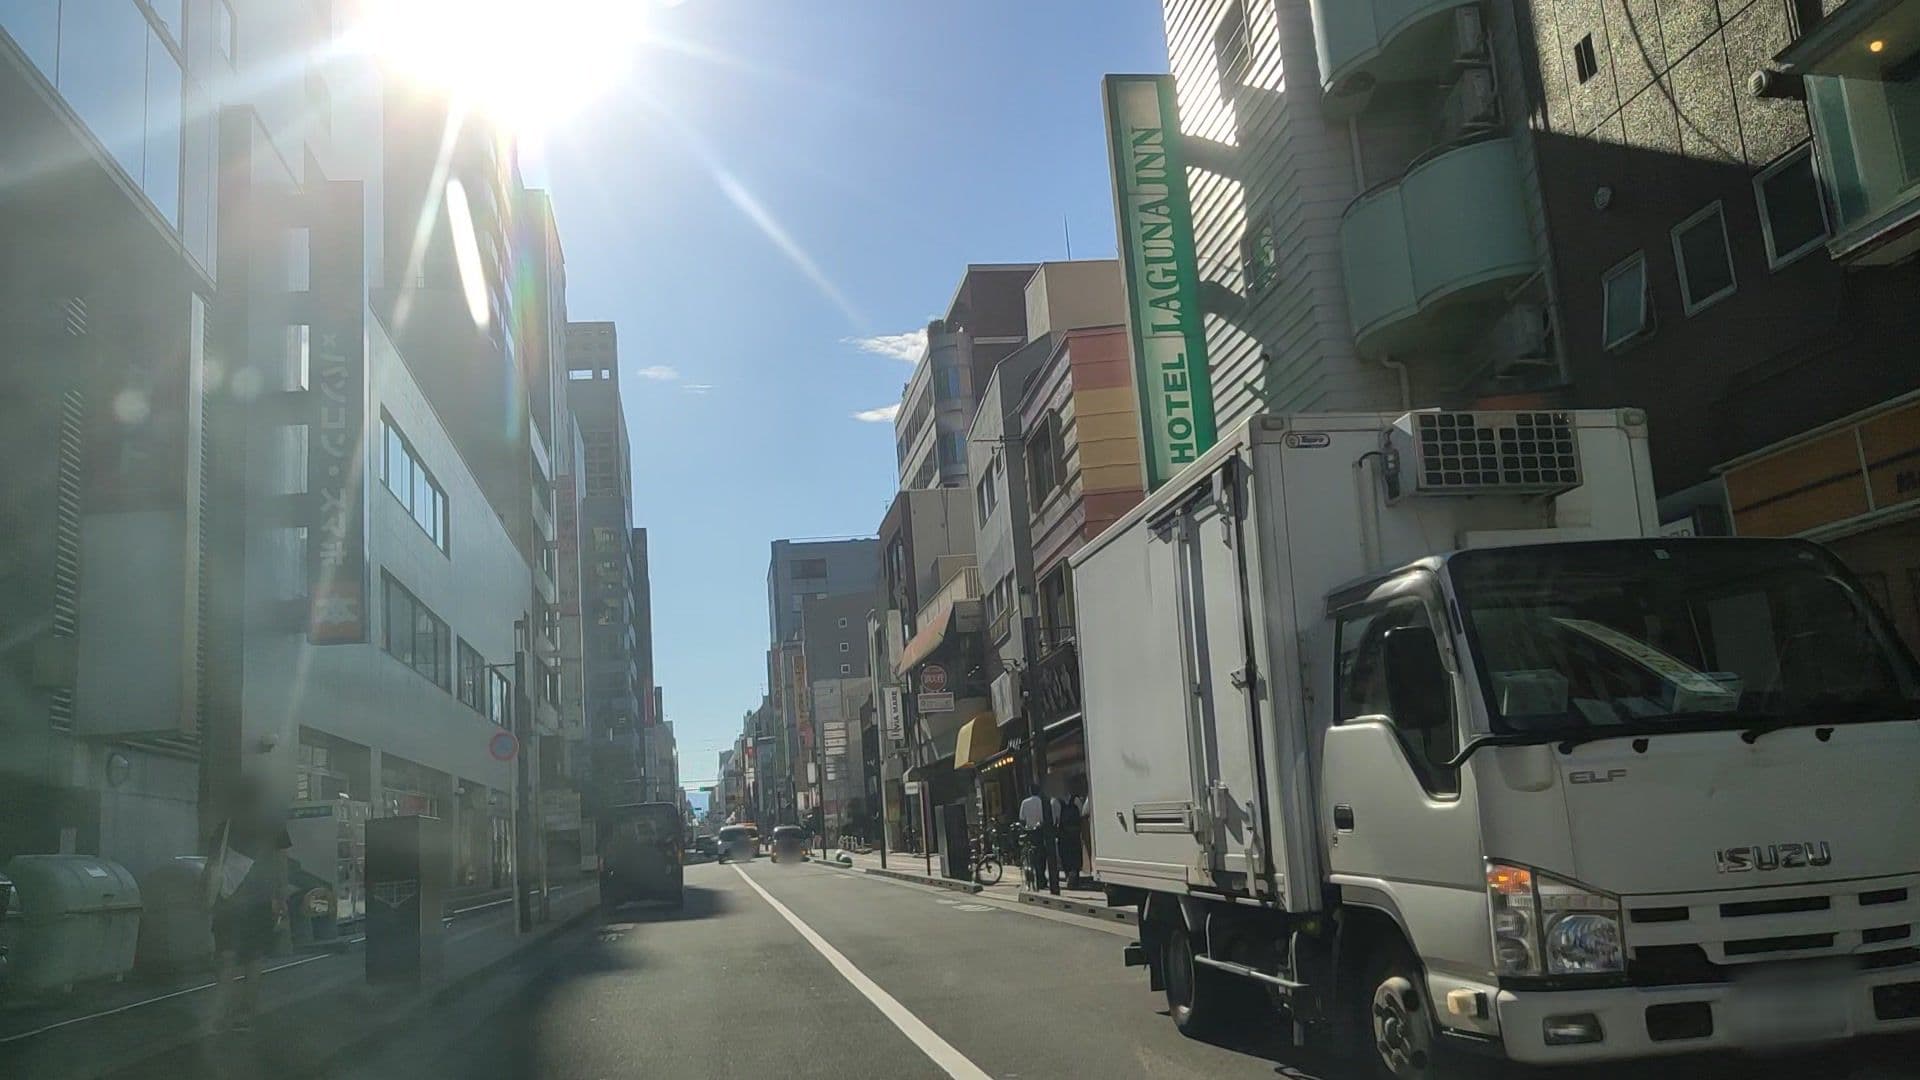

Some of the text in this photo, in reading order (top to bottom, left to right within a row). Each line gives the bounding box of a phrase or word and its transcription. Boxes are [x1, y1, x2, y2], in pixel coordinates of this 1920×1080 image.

[1131, 127, 1195, 464] HOTEL LAGUNA INN
[1568, 769, 1628, 785] ELF
[1713, 841, 1832, 874] ISUZU
